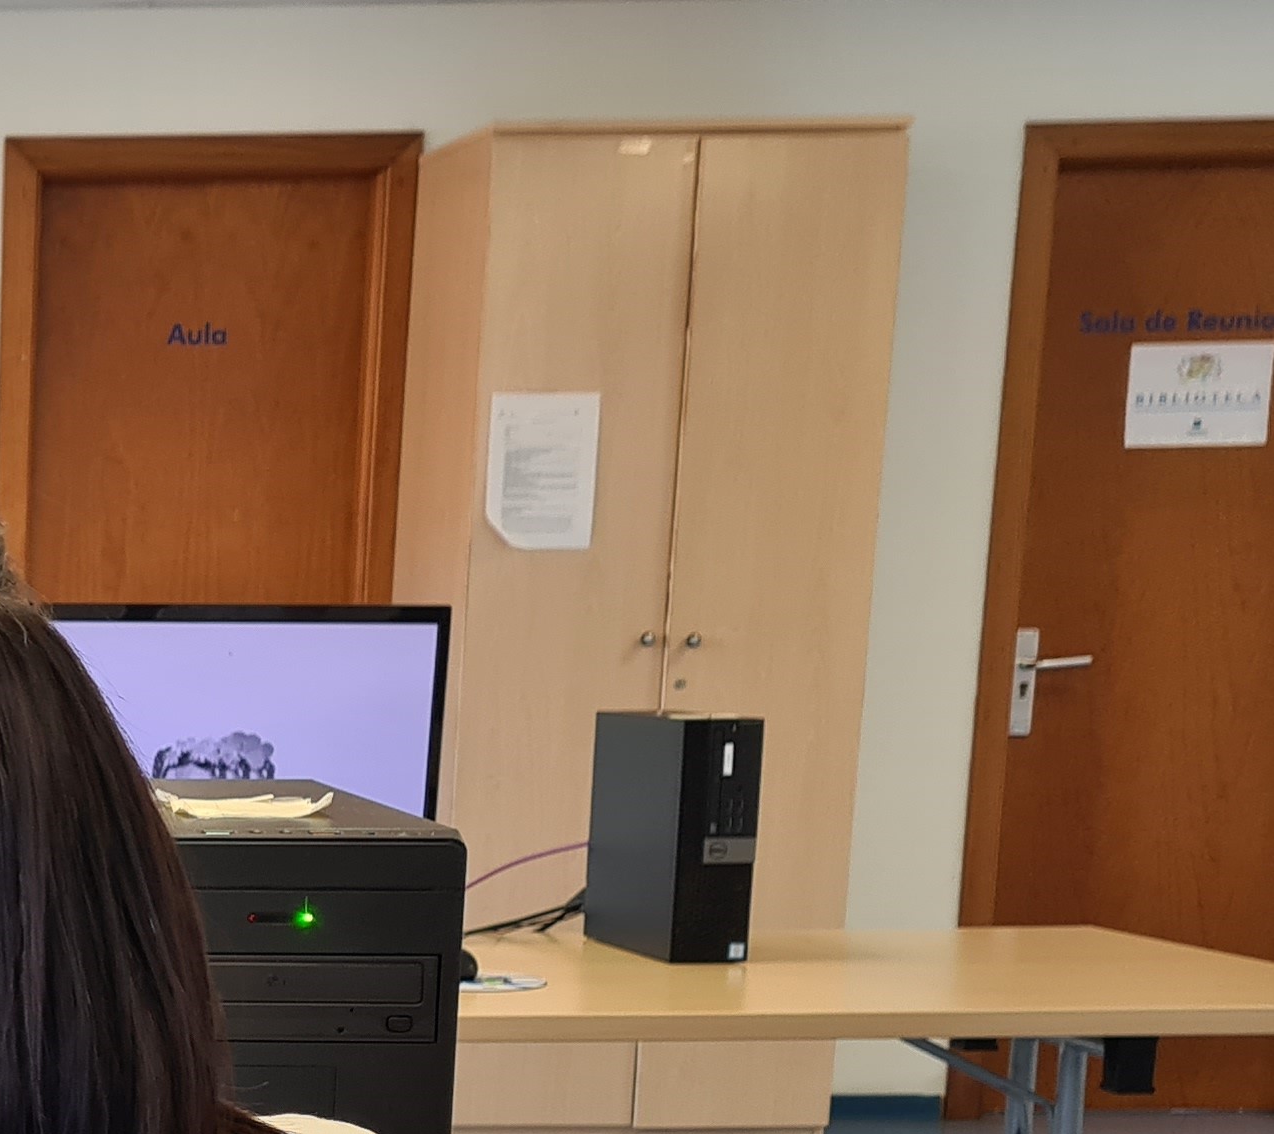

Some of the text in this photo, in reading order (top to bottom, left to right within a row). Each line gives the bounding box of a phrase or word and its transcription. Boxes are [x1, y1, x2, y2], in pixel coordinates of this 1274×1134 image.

[166, 321, 229, 347] Aula
[1080, 311, 1136, 335] Sala
[1145, 309, 1177, 333] de
